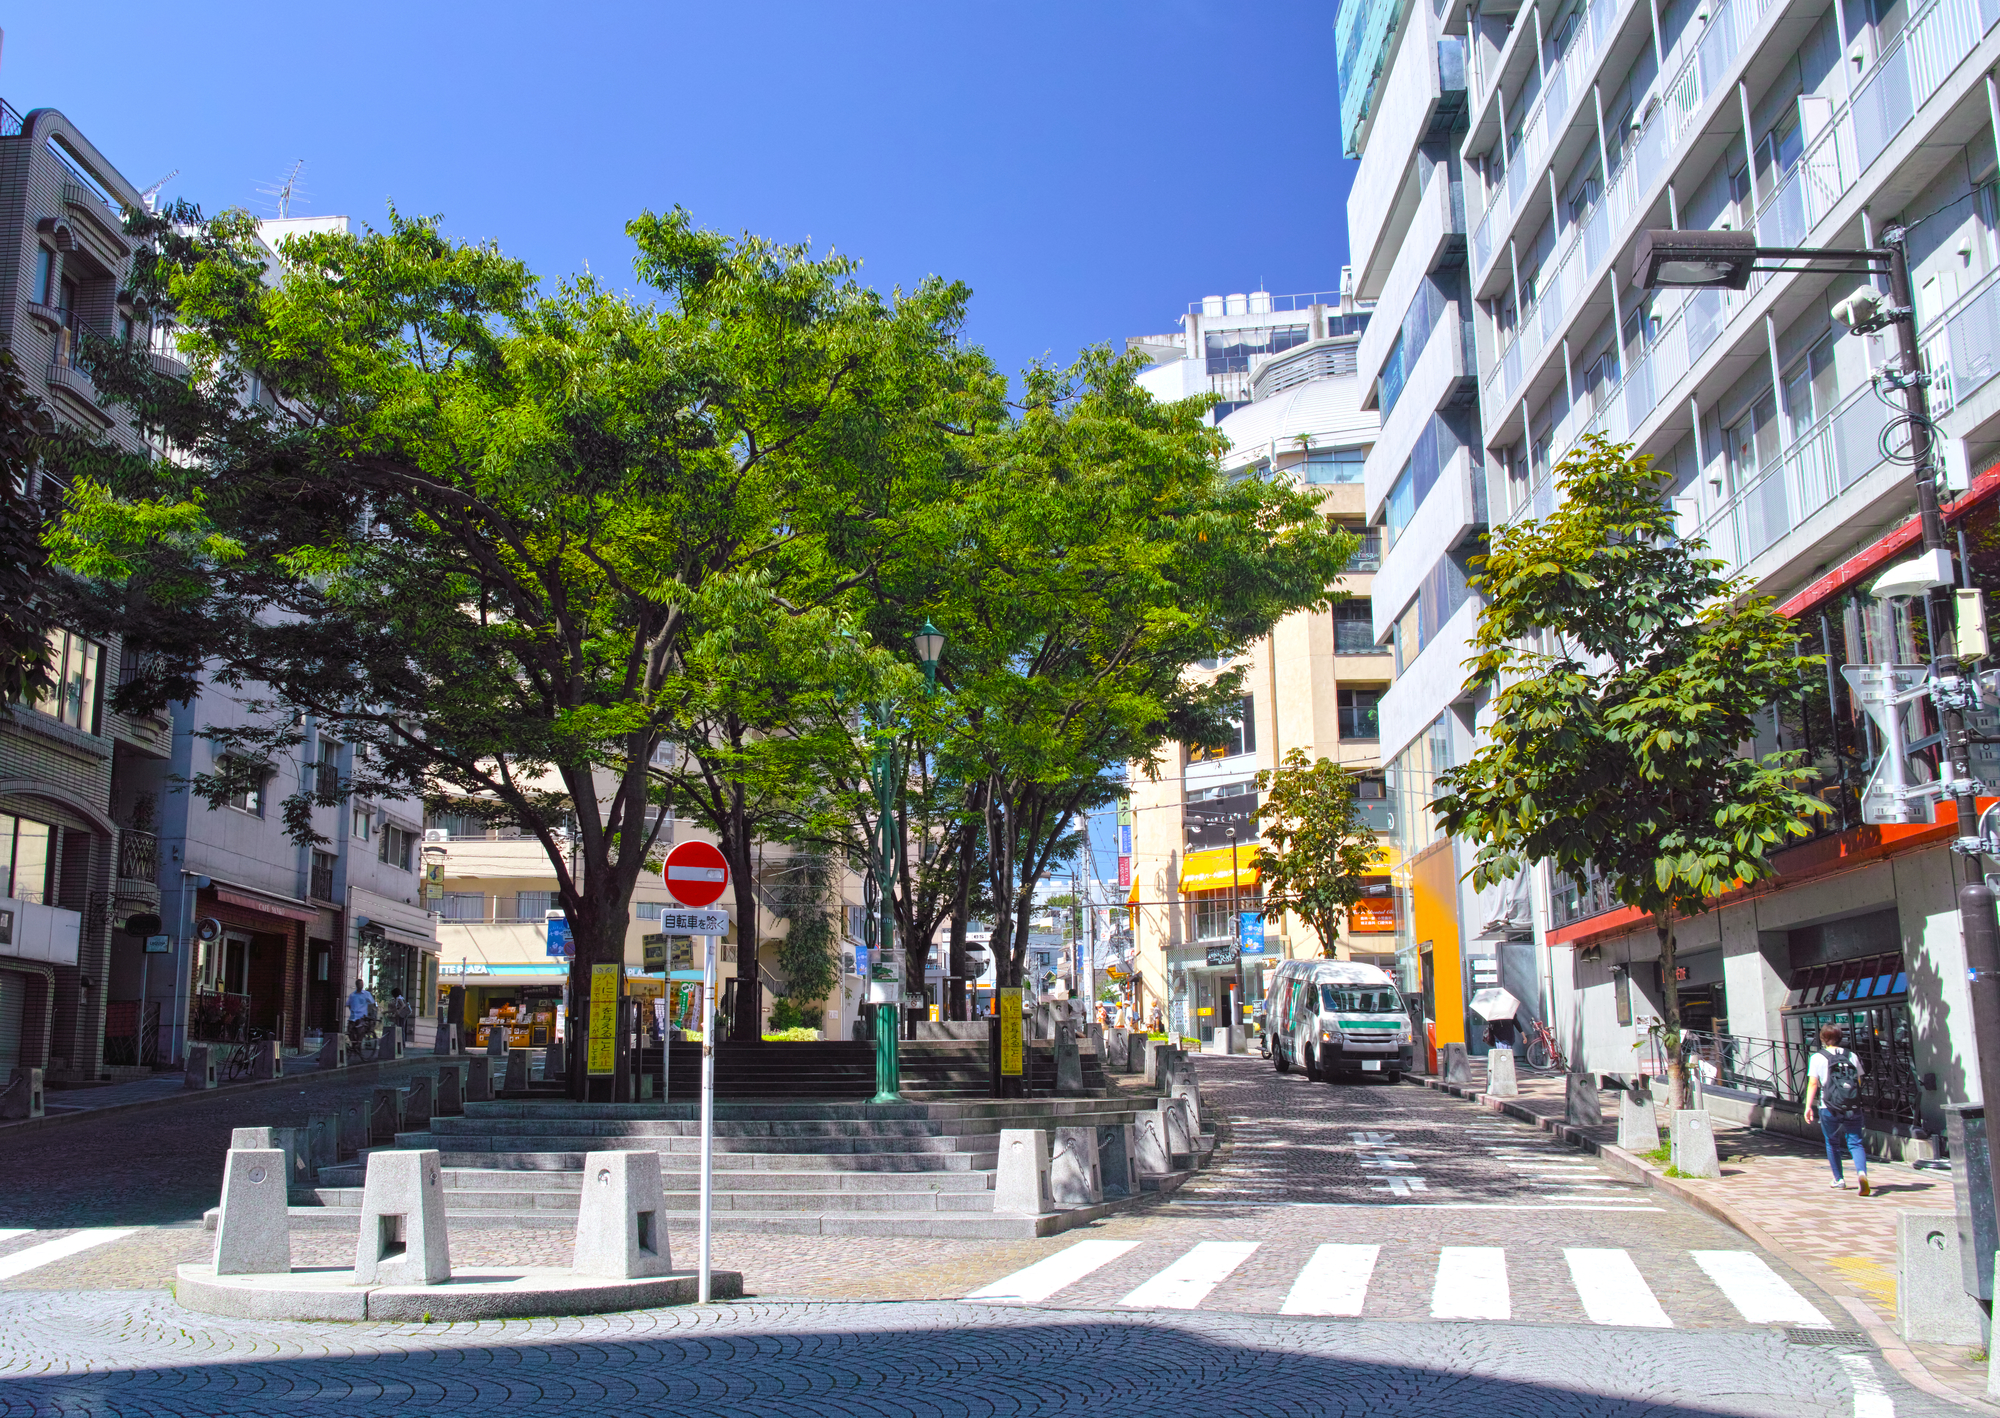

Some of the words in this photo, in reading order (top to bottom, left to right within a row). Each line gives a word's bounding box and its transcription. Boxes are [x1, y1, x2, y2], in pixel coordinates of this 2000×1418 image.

[665, 914, 725, 930] 自転車を除く
